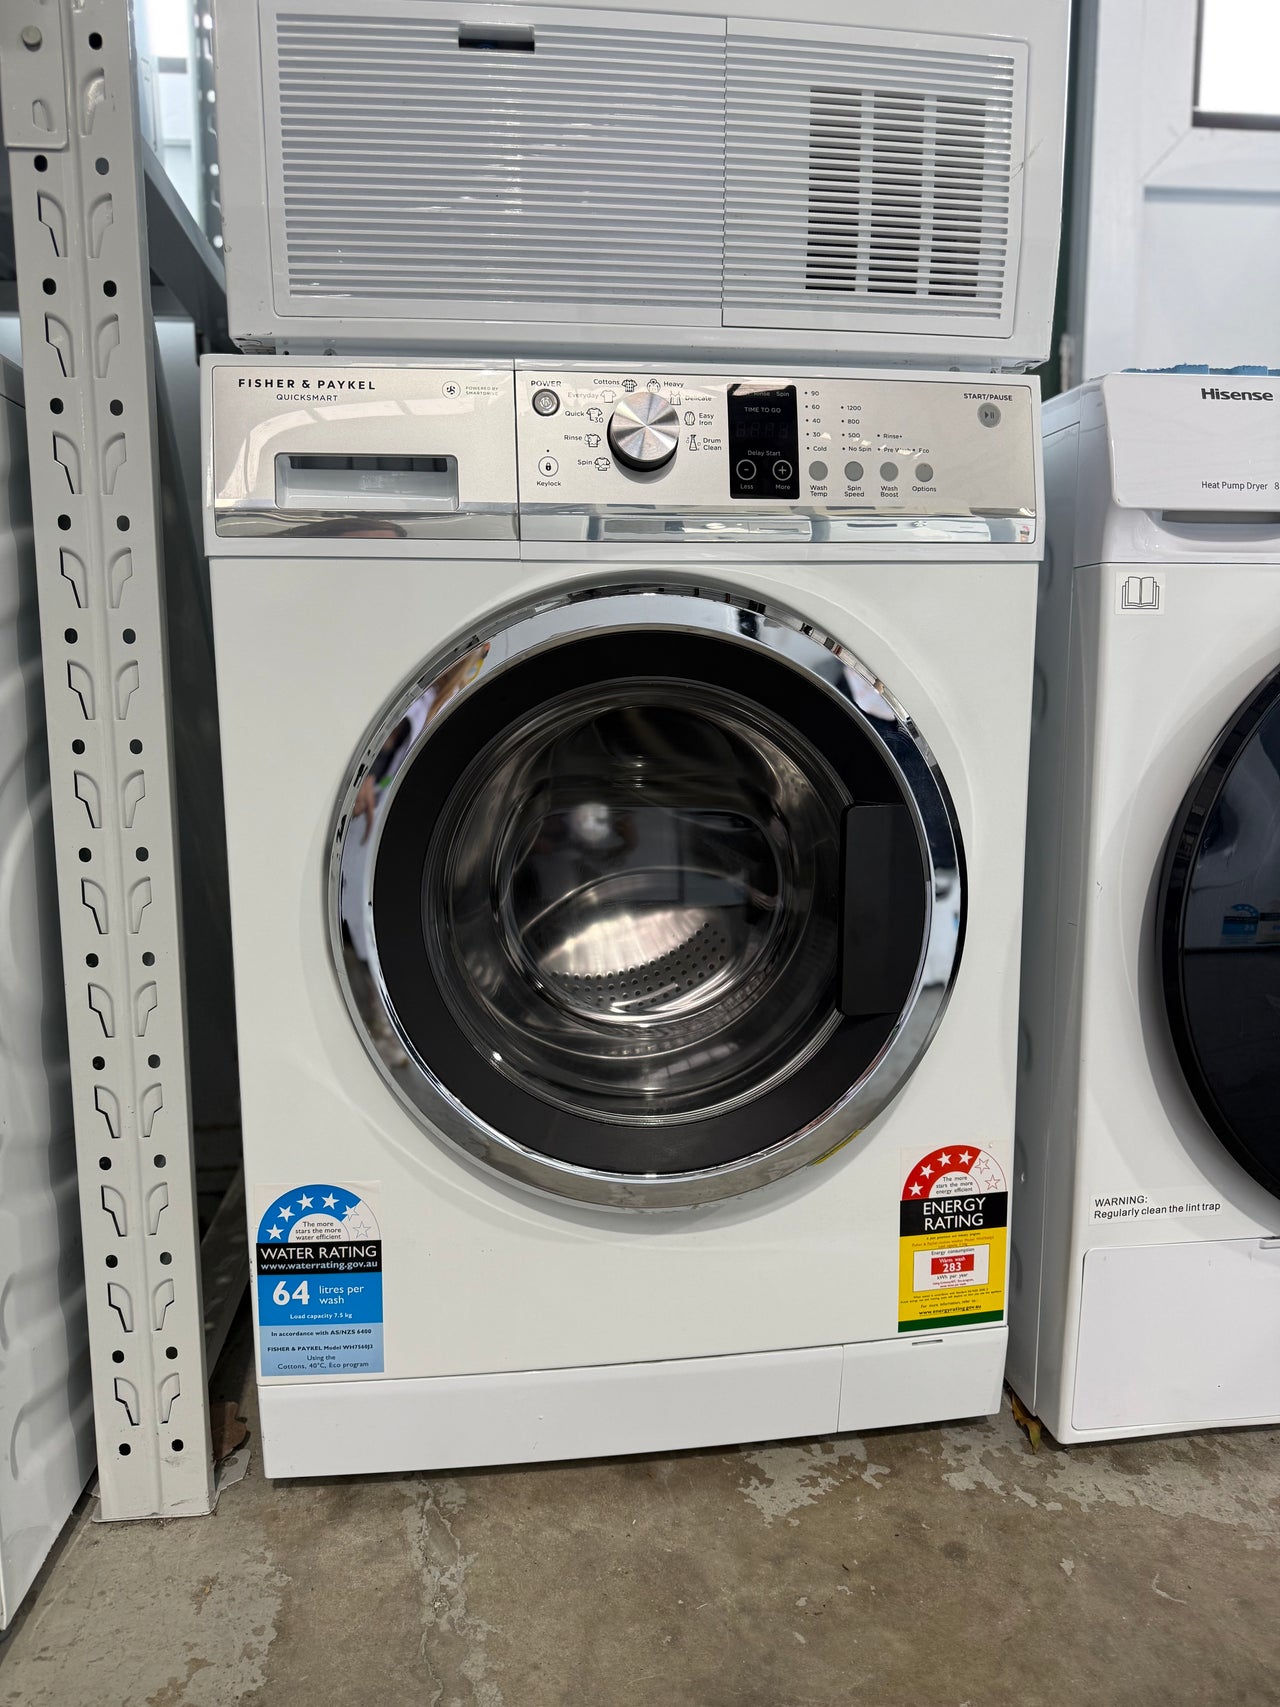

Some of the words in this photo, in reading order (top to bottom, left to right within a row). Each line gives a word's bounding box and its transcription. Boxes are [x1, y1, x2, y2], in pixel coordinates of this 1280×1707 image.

[238, 379, 294, 388] FISHER
[302, 380, 310, 388] &
[318, 380, 376, 390] PAYKEL
[568, 392, 599, 400] Everyday
[964, 393, 1012, 401] START/PAUSE
[1201, 388, 1274, 400] Hisense
[1222, 482, 1244, 491] Pump
[1247, 482, 1268, 491] Dryer
[1274, 482, 1280, 490] 8
[924, 1197, 986, 1215] ENERGY
[1095, 1195, 1148, 1207] WARNING:
[1094, 1208, 1139, 1218] Regularly
[1141, 1205, 1166, 1214] clean
[1202, 1202, 1220, 1211] trap
[925, 1213, 984, 1231] RATING
[261, 1248, 314, 1260] WATER
[320, 1245, 377, 1259] RATING
[260, 1261, 378, 1270] www.waterrating.gov.au
[943, 1263, 962, 1272] 283
[272, 1280, 310, 1305] 64
[319, 1285, 344, 1294] litres
[347, 1286, 364, 1295] per
[319, 1296, 344, 1304] wash
